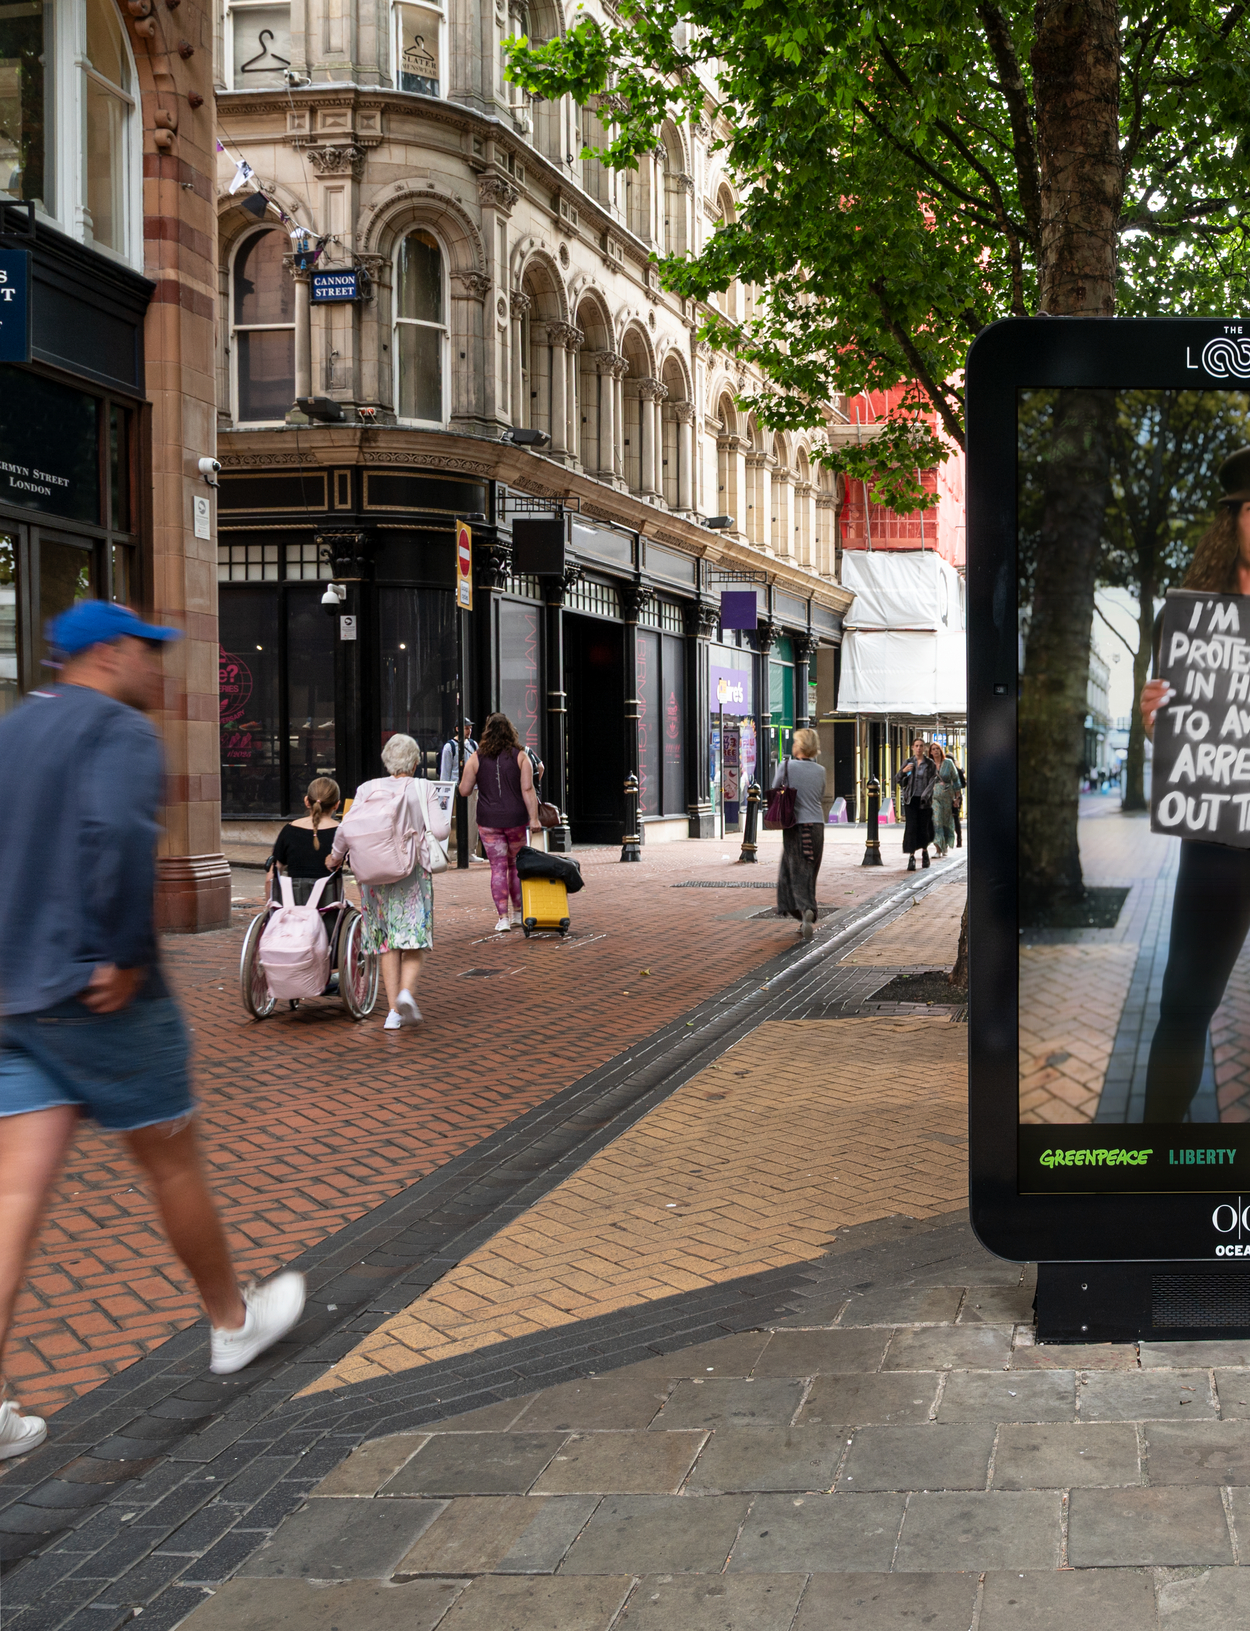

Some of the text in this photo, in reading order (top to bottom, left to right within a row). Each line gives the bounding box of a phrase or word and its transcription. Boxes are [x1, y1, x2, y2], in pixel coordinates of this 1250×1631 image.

[402, 55, 437, 69] SLATER
[314, 275, 355, 286] CANNON
[315, 287, 354, 297] STREET
[1223, 326, 1243, 334] THE
[9, 476, 51, 496] LONDON
[32, 468, 70, 487] STREET
[1187, 600, 1240, 633] I'M
[1183, 670, 1216, 702] IN
[637, 639, 648, 811] BIRMINGHAM
[1167, 705, 1210, 741] TO
[1157, 791, 1231, 831] OUT
[1039, 1148, 1153, 1169] GREENPEACE
[1169, 1149, 1236, 1165] LIBERTY
